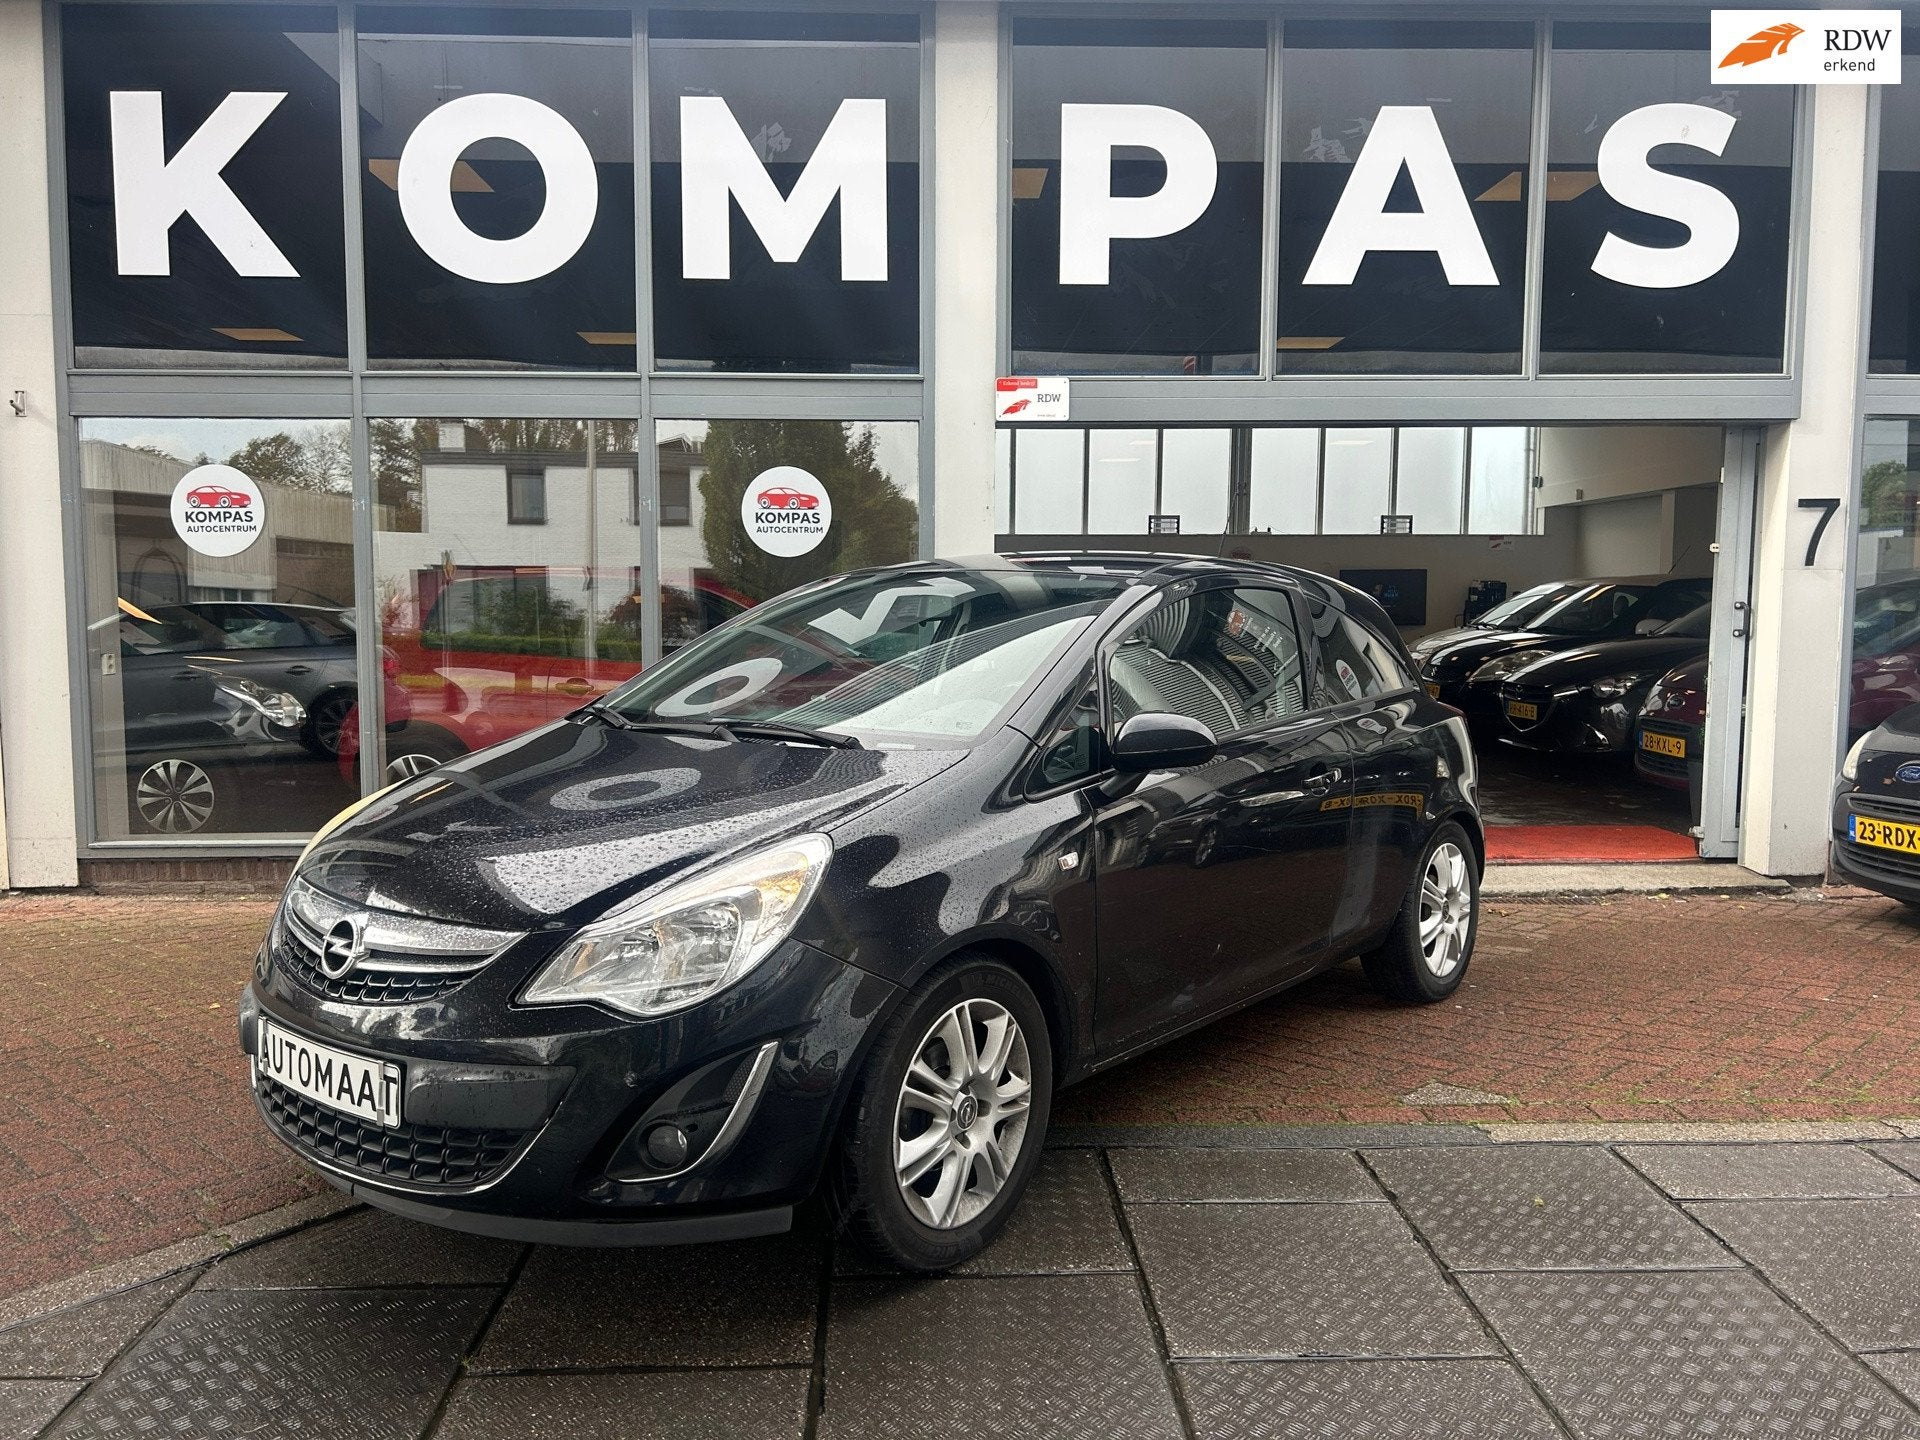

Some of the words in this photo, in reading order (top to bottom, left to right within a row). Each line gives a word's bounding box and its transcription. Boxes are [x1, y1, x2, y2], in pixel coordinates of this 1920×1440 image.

[110, 90, 1741, 289] KOMPAS
[1037, 393, 1061, 403] RDW
[185, 510, 254, 523] KOMPAS
[755, 512, 821, 524] KOMPAS
[186, 525, 257, 533] AUTOCENTRUM
[756, 526, 824, 534] AUTOCENTRUM
[1798, 498, 1841, 566] 7
[1644, 734, 1682, 755] 28-KXL-9
[260, 1033, 397, 1116] AUTOMAAT
